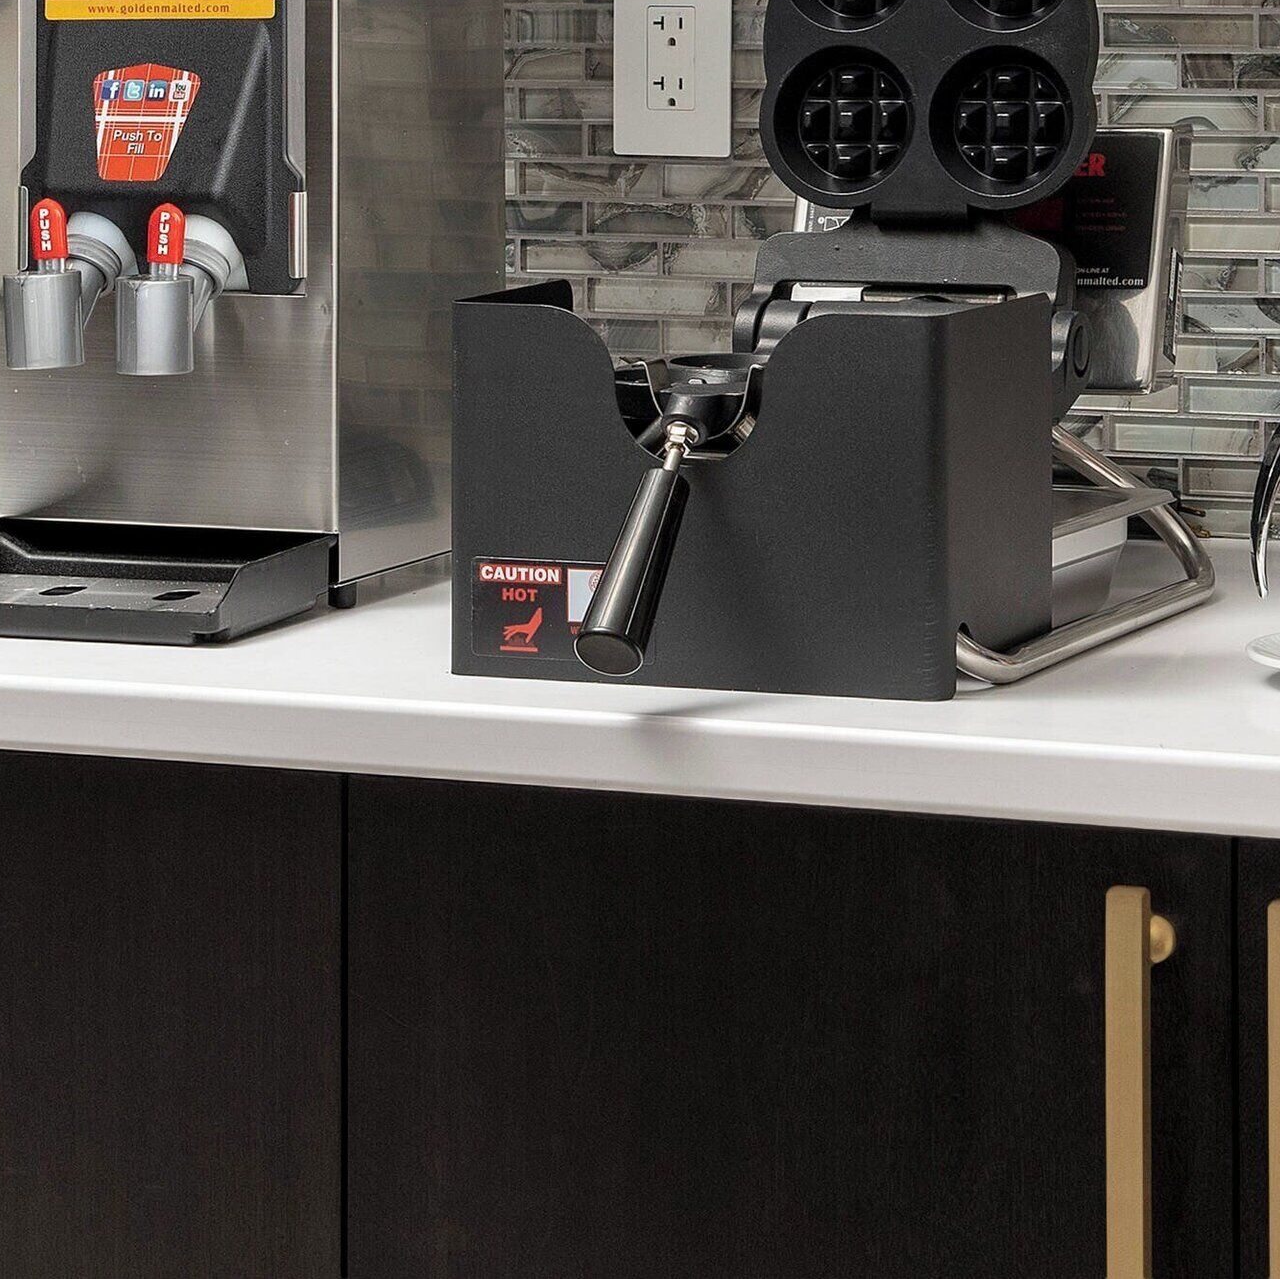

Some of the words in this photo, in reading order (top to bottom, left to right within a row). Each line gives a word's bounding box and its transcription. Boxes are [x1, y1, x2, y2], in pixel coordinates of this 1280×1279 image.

[88, 0, 230, 14] www.goldenmalted.com
[113, 129, 143, 142] Push
[146, 129, 163, 142] To
[127, 142, 145, 155] Fill
[39, 208, 52, 252] PUSH
[157, 211, 171, 256] PUSH
[1077, 276, 1144, 287] nmalted.com
[480, 565, 560, 583] CAUTION
[501, 588, 538, 602] HOT
